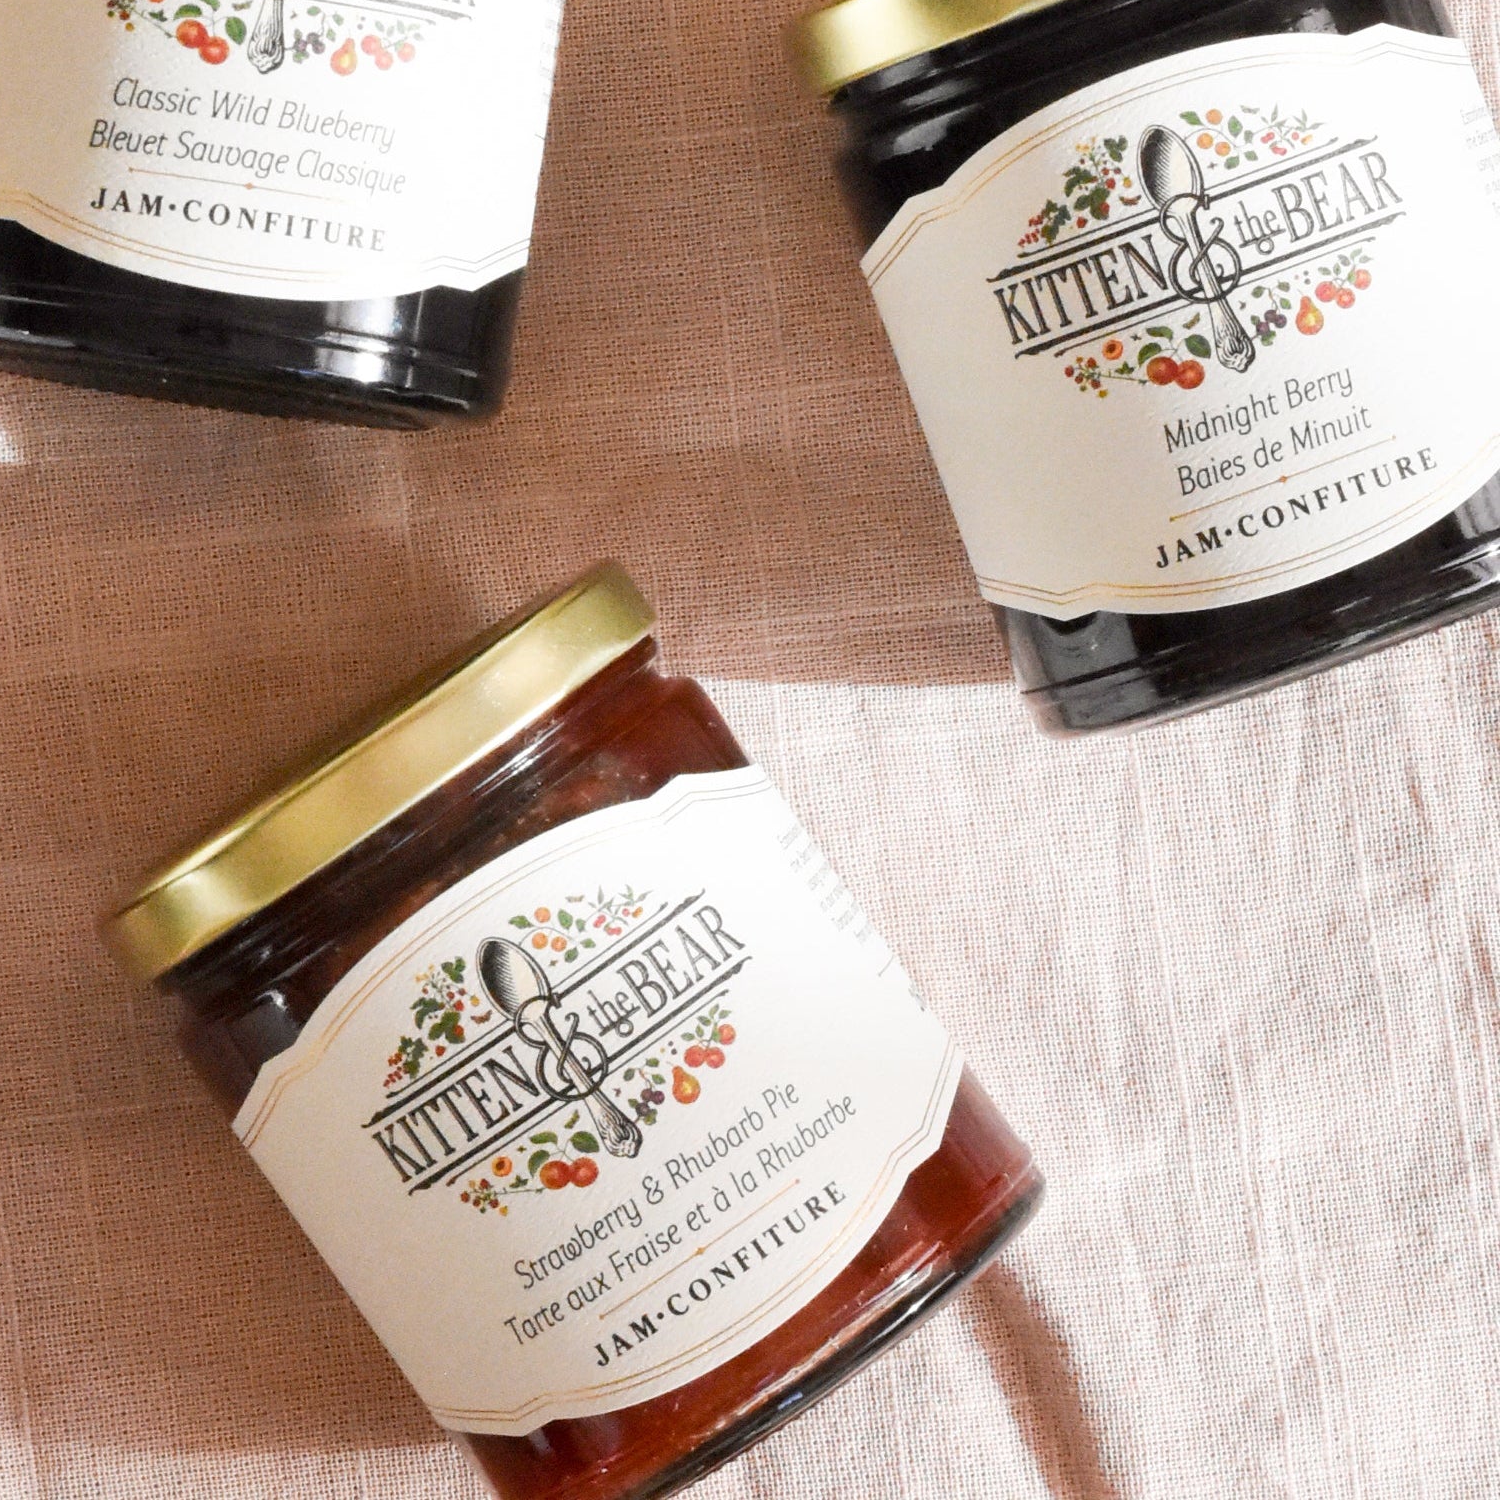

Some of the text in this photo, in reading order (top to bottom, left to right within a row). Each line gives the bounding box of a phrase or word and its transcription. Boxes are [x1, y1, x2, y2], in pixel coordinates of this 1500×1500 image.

[88, 118, 406, 194] Bleuet Sauvage Classique
[112, 76, 394, 154] Classic Wild Blueberry
[994, 234, 1170, 345] KITTEN
[1233, 203, 1286, 256] the
[1271, 150, 1403, 243] BEAR
[1163, 368, 1353, 454] Midnight Berry
[1176, 405, 1372, 497] Baies de Minuit
[371, 1046, 540, 1184] KITTEN
[588, 983, 639, 1038] the
[625, 904, 746, 1019] BEAR
[503, 1095, 857, 1346] Tarte aux Fraise et à la Rhubarbe
[513, 1083, 800, 1290] Strawberry & Rhubarb Pie
